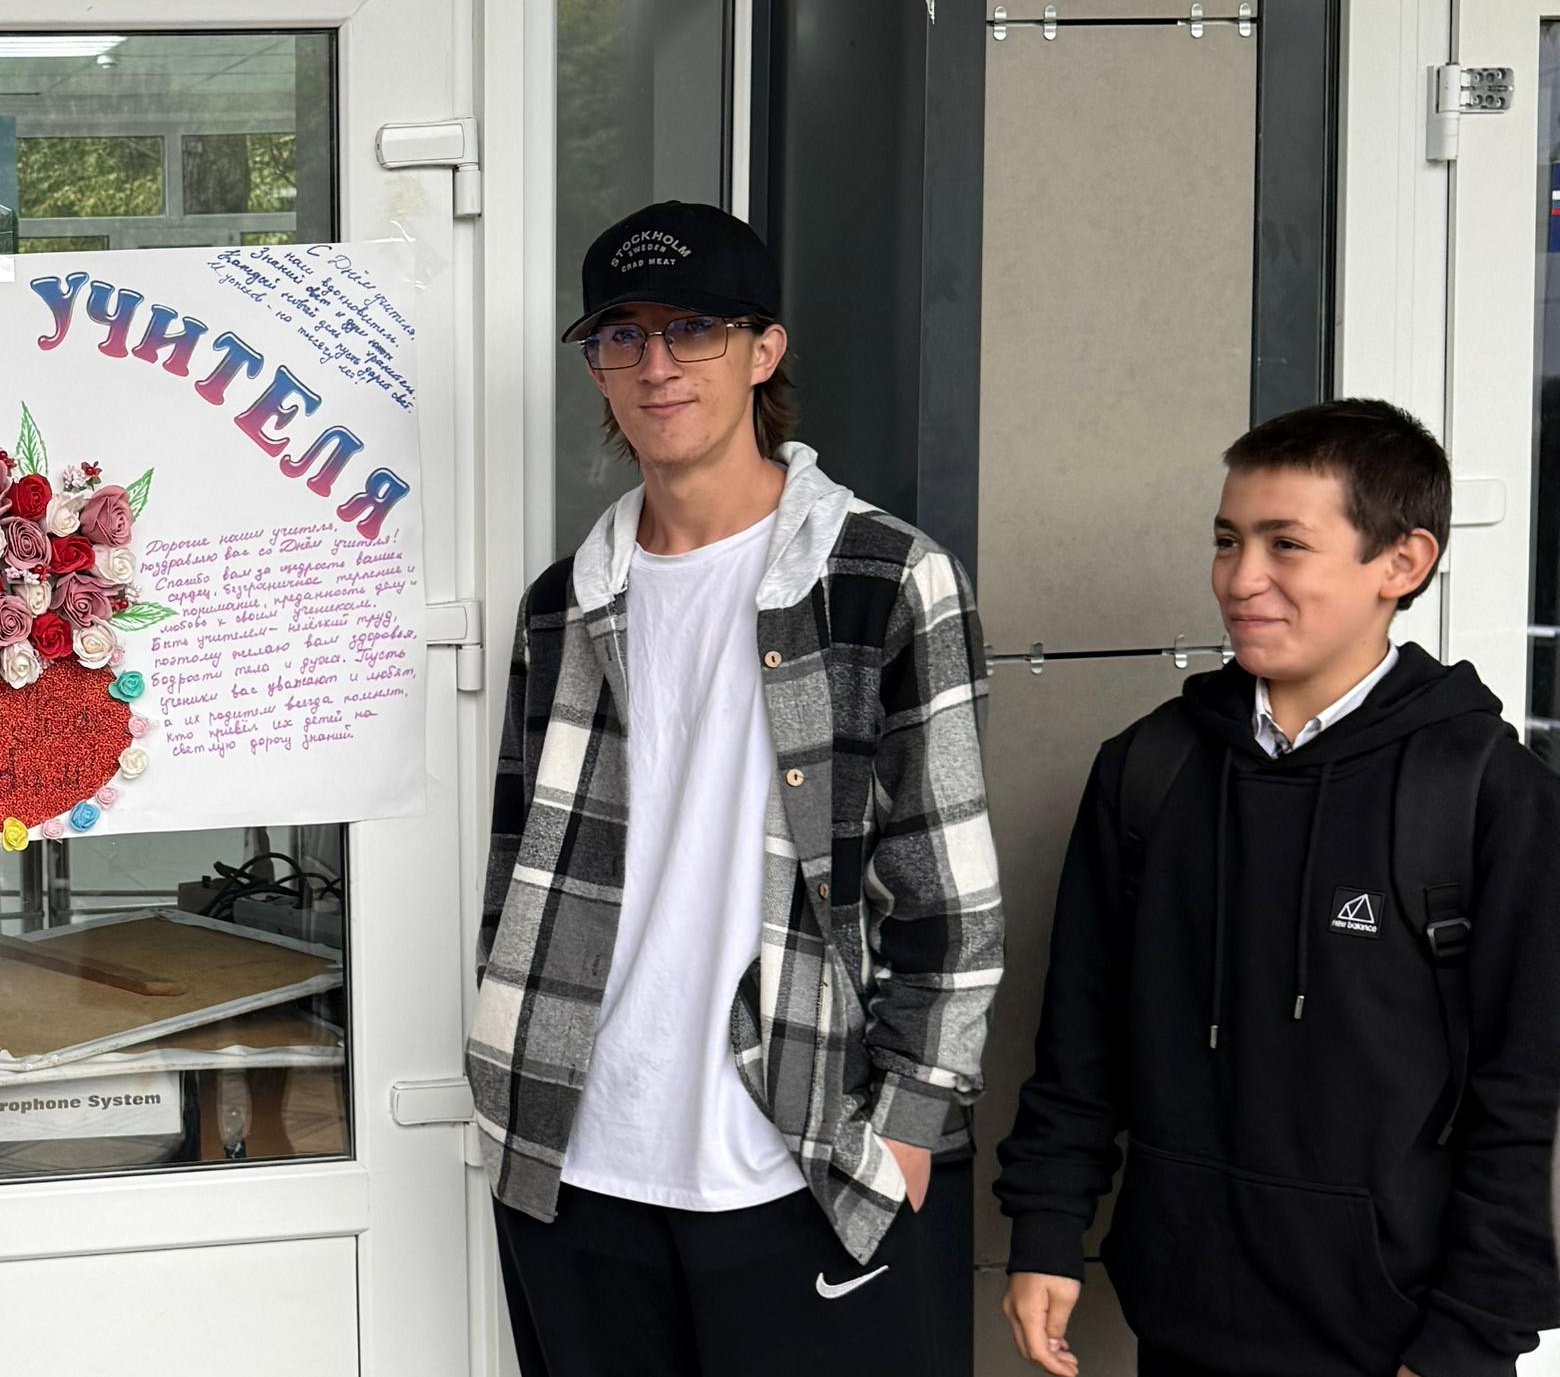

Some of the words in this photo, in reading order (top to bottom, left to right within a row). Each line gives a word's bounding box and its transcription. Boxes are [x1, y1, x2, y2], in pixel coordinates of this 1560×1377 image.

[307, 245, 332, 256] С
[611, 230, 691, 267] STOCKHOLM
[30, 272, 410, 540] УЧИТЕЛЯ
[146, 538, 210, 559] Дорогие
[219, 529, 264, 544] наши
[140, 553, 217, 577] поздравляю
[225, 546, 249, 560] вас
[258, 548, 272, 556] со
[155, 572, 210, 591] Спасибо
[223, 566, 251, 580] вам
[255, 567, 271, 580] за
[280, 561, 345, 578] щедрость
[336, 566, 402, 586] терпение
[236, 610, 278, 623] своим
[151, 637, 189, 652] Быть
[155, 652, 222, 668] поэтому
[232, 642, 290, 660] желаю
[304, 633, 339, 648] вам
[151, 671, 223, 694] бодрости
[234, 663, 270, 677] тела
[285, 660, 291, 669] и
[354, 647, 406, 668] Пусть
[160, 693, 218, 715] ученики
[231, 683, 259, 699] вас
[267, 674, 338, 697] уважают
[349, 673, 358, 682] и
[164, 718, 173, 727] а
[184, 714, 200, 725] их
[209, 705, 276, 727] родители
[285, 695, 334, 714] всегда
[167, 731, 194, 743] кто
[272, 718, 293, 730] их
[303, 710, 343, 733] детей
[354, 709, 379, 719] на
[172, 741, 236, 758] светлую
[249, 736, 292, 755] дорогу
[88, 1093, 161, 1110] System
